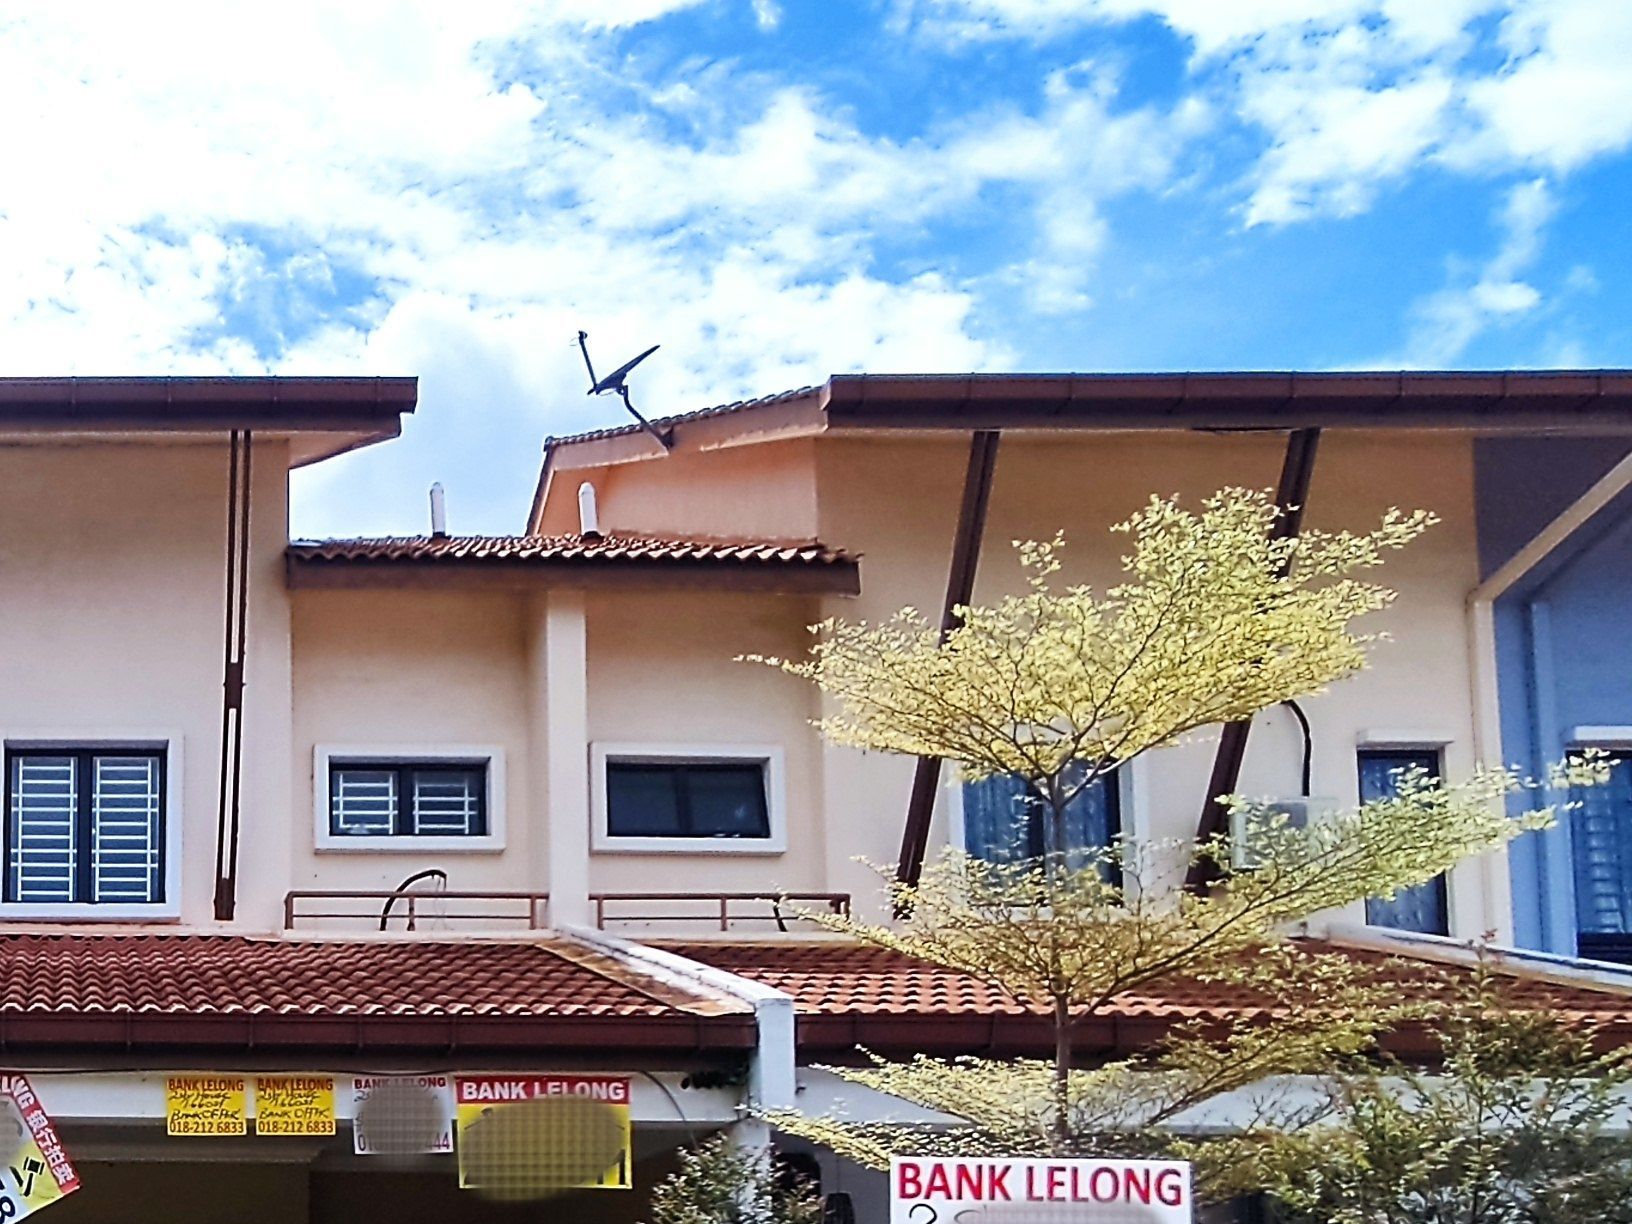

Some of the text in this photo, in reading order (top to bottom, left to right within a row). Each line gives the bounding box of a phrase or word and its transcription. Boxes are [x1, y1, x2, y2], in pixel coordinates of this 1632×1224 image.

[168, 1079, 244, 1091] BANK LELONG
[258, 1078, 334, 1090] BANK LELONG
[463, 1082, 625, 1100] BANK LELONG
[169, 1121, 244, 1133] 018-212 6833
[258, 1121, 334, 1133] 018-212 6833
[897, 1162, 1182, 1206] BANK LELONG
